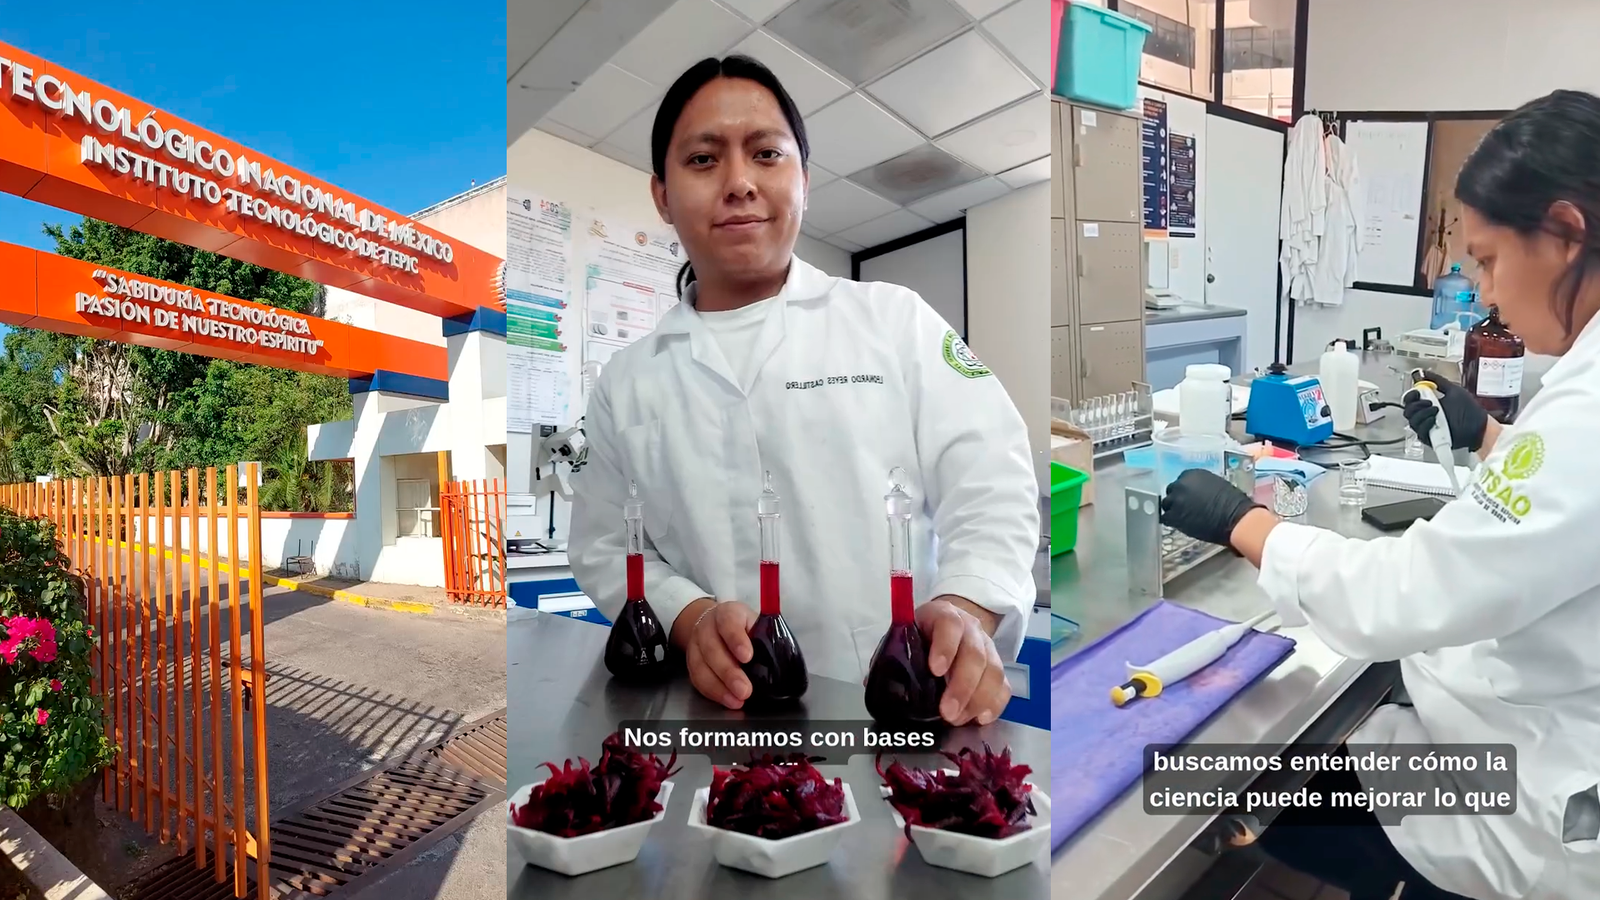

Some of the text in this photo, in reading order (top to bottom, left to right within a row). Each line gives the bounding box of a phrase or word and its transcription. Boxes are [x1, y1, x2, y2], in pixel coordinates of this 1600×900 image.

[0, 56, 235, 178] TECNOLÓGICO
[237, 155, 362, 227] NACIONAL
[360, 207, 388, 237] DE
[387, 220, 453, 263] MÉXICO
[81, 134, 419, 274] INSTITUTO TECNOLÓGICO DE TEPIC
[75, 291, 151, 325] PASIÓN
[153, 308, 179, 330] DE
[182, 313, 259, 344] NUESTRO
[205, 298, 312, 335] TECNOLÓGICA
